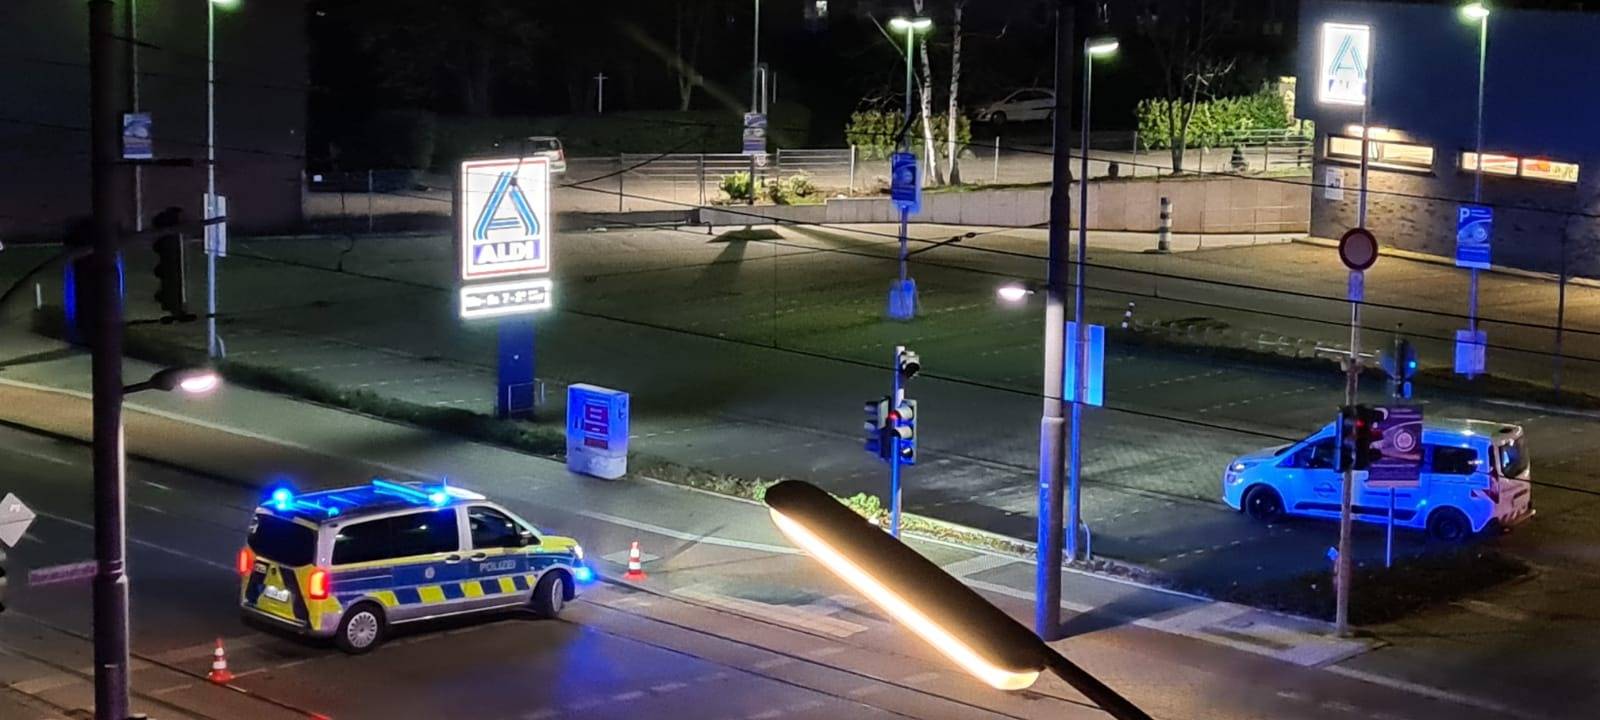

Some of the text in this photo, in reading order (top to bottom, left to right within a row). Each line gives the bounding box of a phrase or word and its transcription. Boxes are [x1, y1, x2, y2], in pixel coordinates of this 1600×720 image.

[1459, 208, 1470, 223] P
[476, 241, 534, 265] ALDI
[480, 560, 516, 573] POLIZEI
